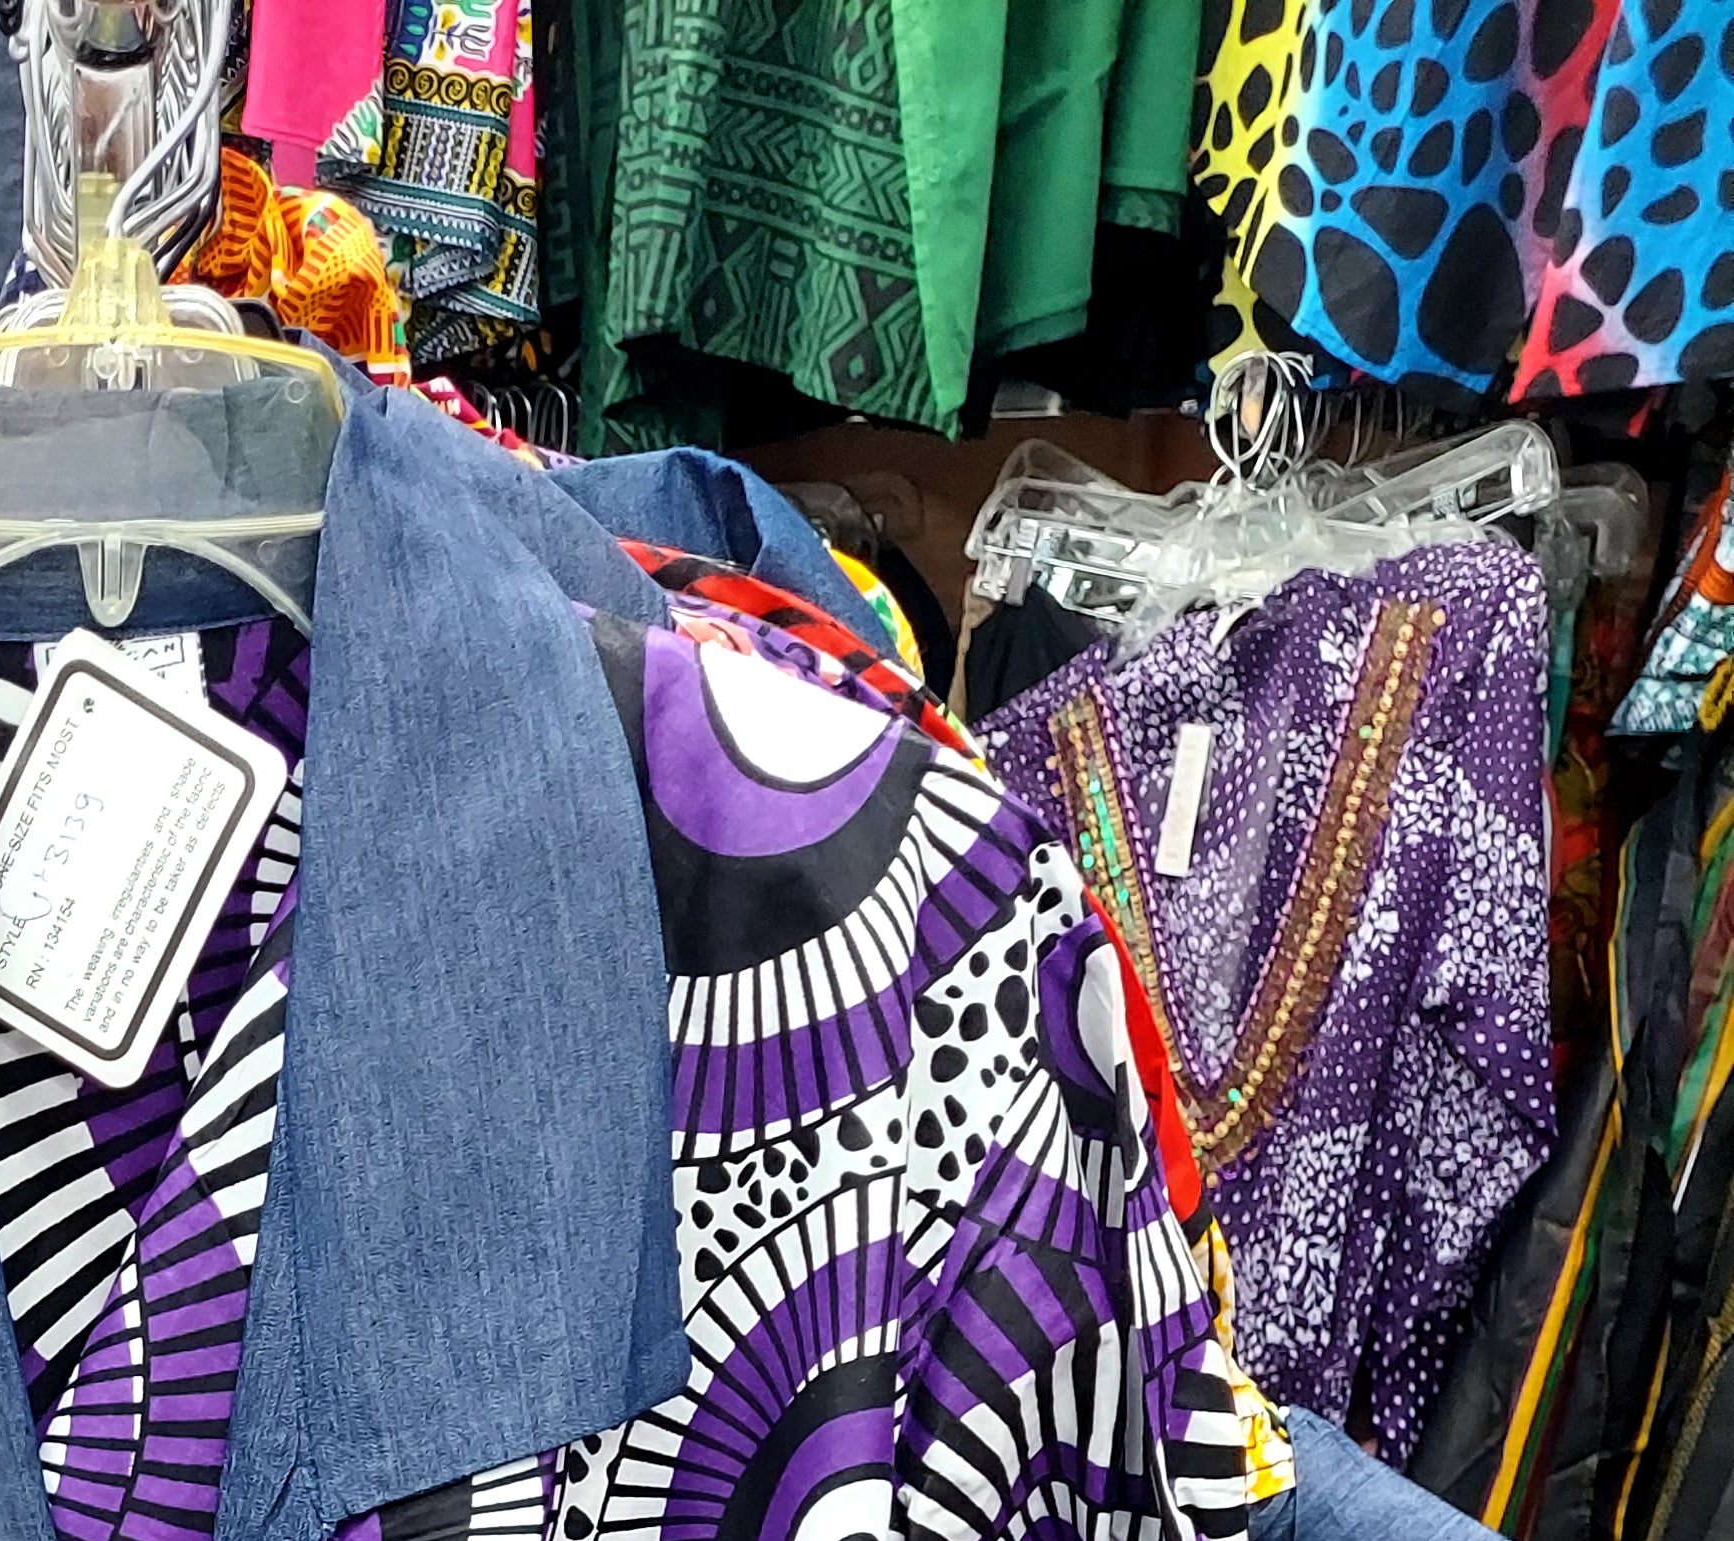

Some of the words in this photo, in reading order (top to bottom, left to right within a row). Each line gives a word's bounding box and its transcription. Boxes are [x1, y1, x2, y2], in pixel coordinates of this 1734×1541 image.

[8, 810, 34, 852] SIZE
[26, 770, 51, 811] FITS
[46, 718, 78, 769] MOST
[65, 987, 84, 1012] The
[82, 927, 115, 980] weaving
[153, 805, 171, 833] and
[169, 757, 196, 799] shade
[98, 1005, 116, 1033] and
[110, 990, 124, 1004] in
[120, 968, 134, 987] no
[131, 936, 150, 964] way
[144, 918, 158, 933] to
[151, 896, 168, 915] be
[184, 835, 198, 853] as
[112, 937, 128, 960] are
[167, 828, 177, 846] of
[173, 807, 191, 829] the
[25, 961, 45, 989] RN
